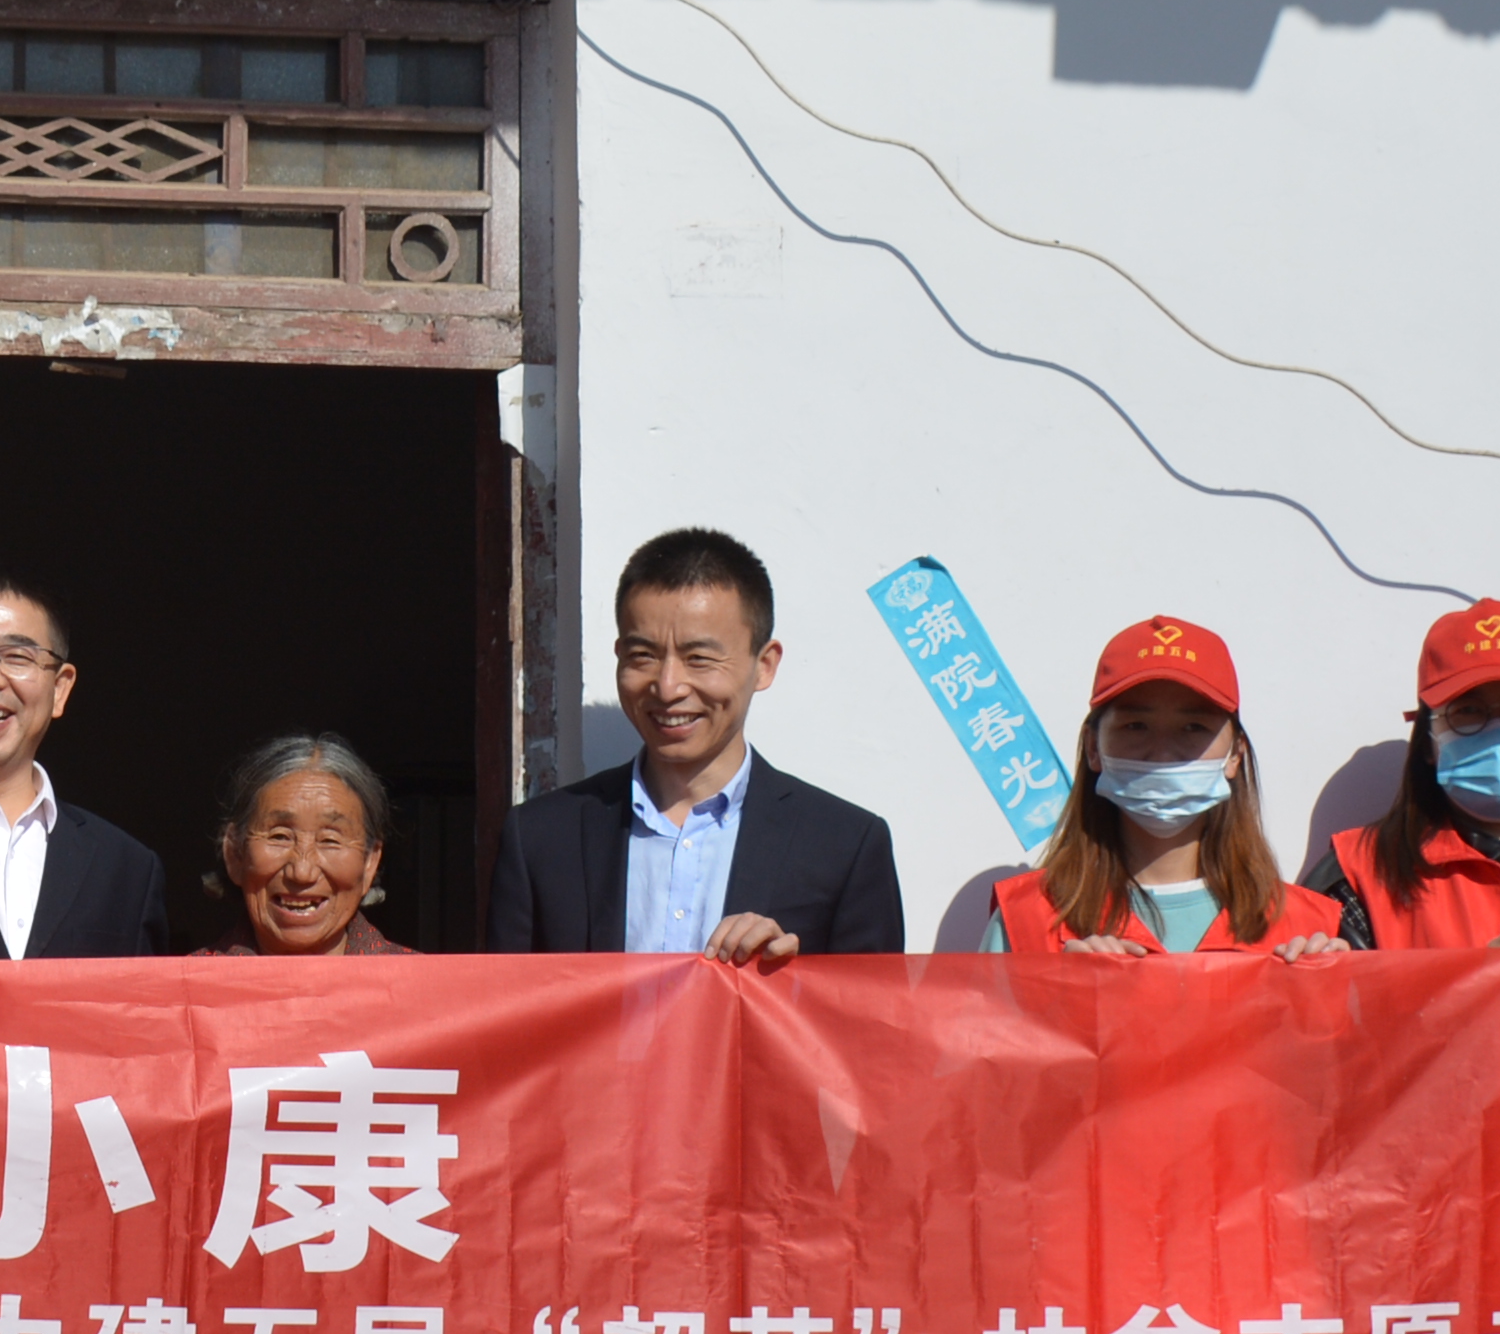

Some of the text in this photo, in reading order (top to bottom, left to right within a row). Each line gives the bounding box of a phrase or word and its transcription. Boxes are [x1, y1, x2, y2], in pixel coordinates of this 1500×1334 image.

[904, 597, 1060, 810] 满院春光
[1136, 644, 1199, 663] 中建五局
